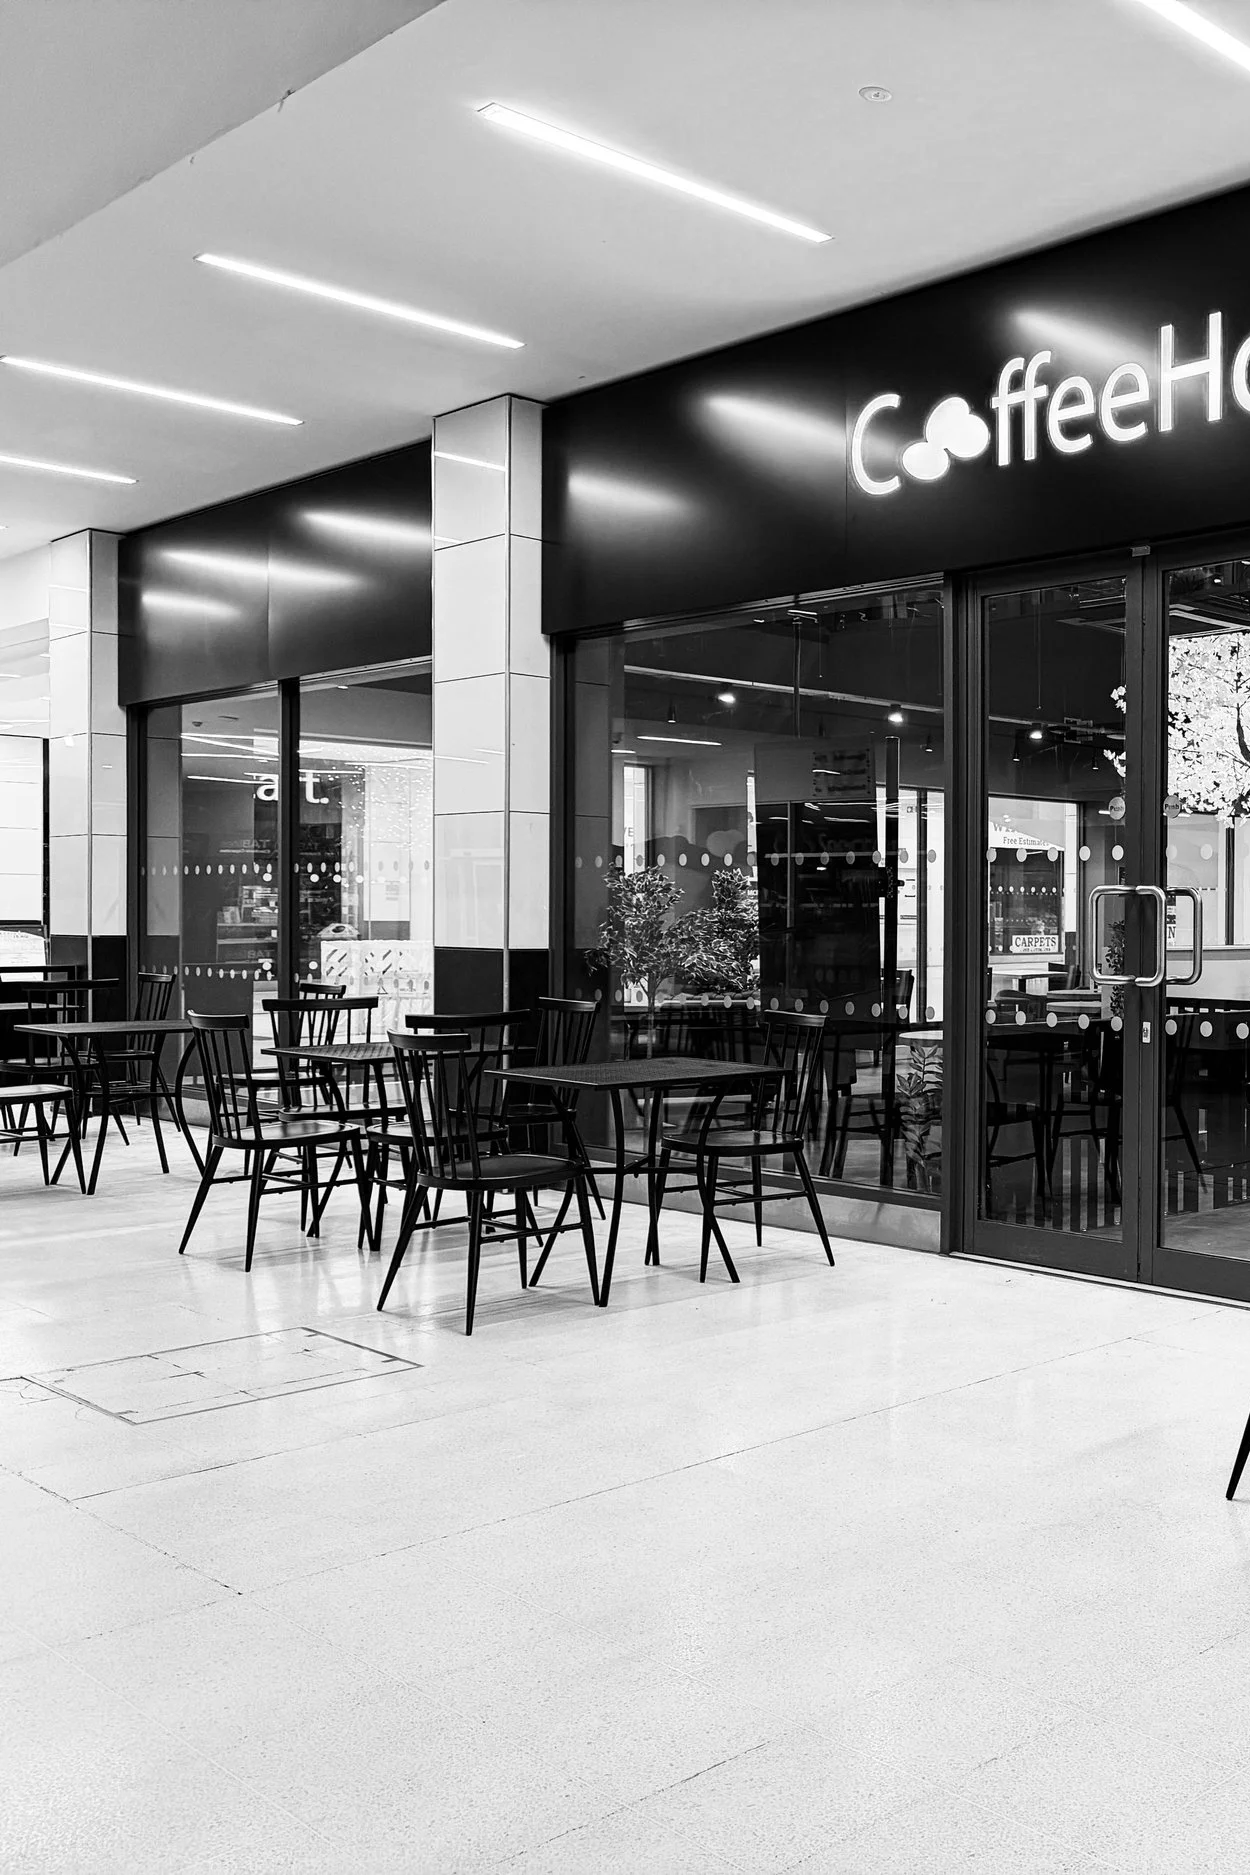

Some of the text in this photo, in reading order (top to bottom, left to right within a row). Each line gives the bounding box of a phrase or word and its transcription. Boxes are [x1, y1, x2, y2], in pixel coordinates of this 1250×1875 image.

[256, 773, 329, 804] at.
[1003, 837, 1017, 845] Free
[1014, 937, 1057, 948] CARPETS
